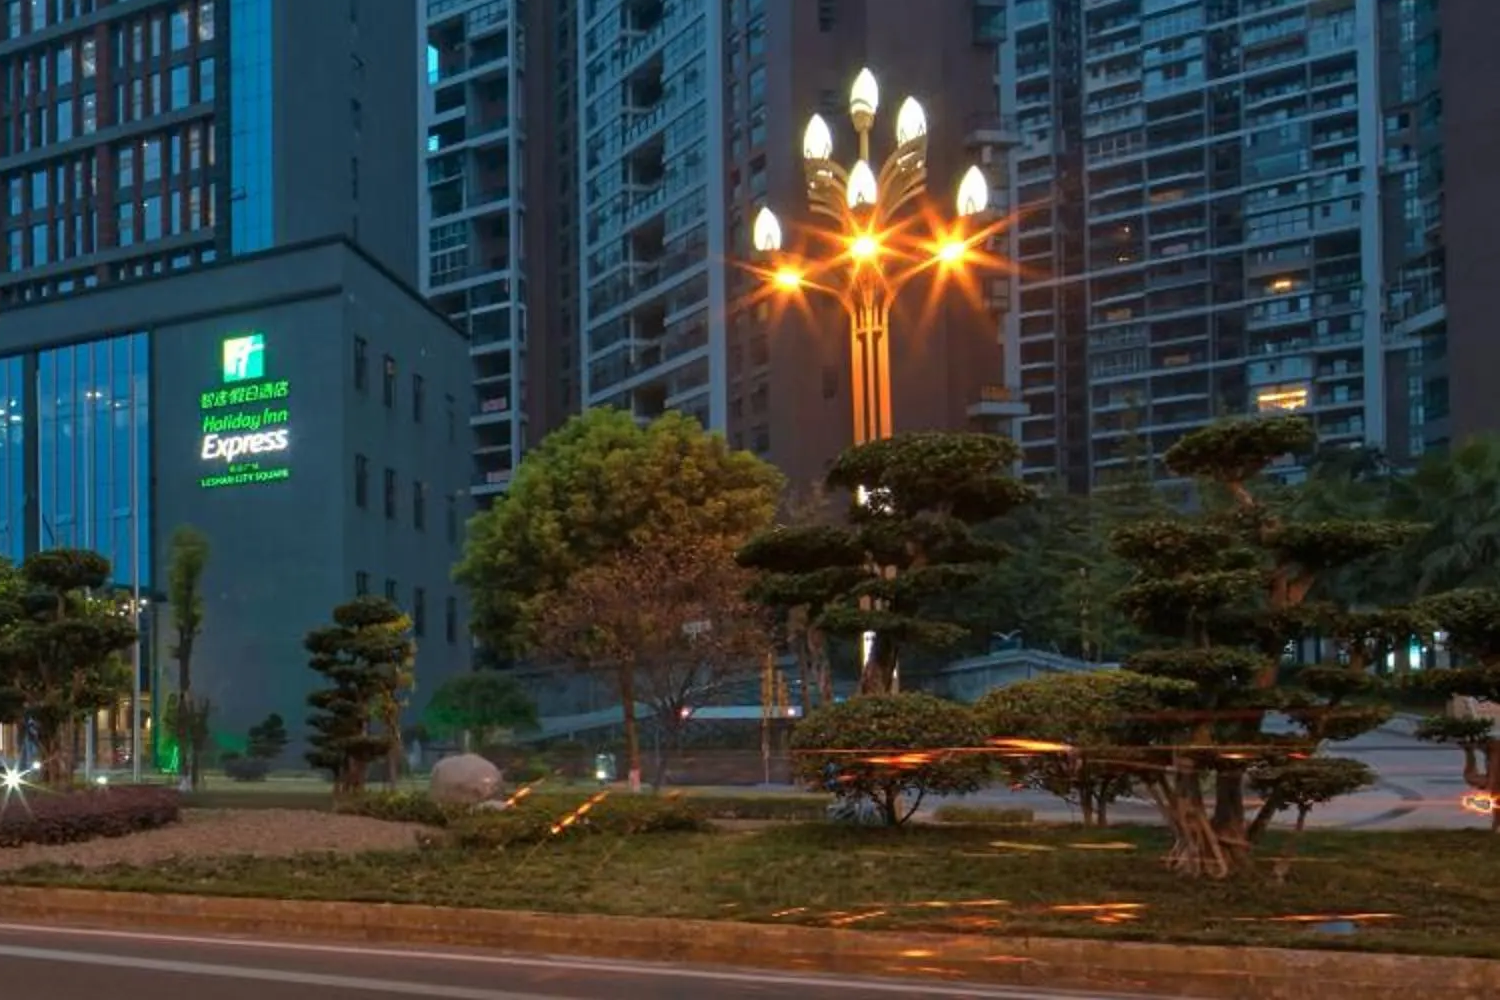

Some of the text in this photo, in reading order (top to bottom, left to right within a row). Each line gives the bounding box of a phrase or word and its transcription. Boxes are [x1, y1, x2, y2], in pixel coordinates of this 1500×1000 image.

[203, 408, 289, 433] Holiday Inn
[201, 429, 289, 463] Express
